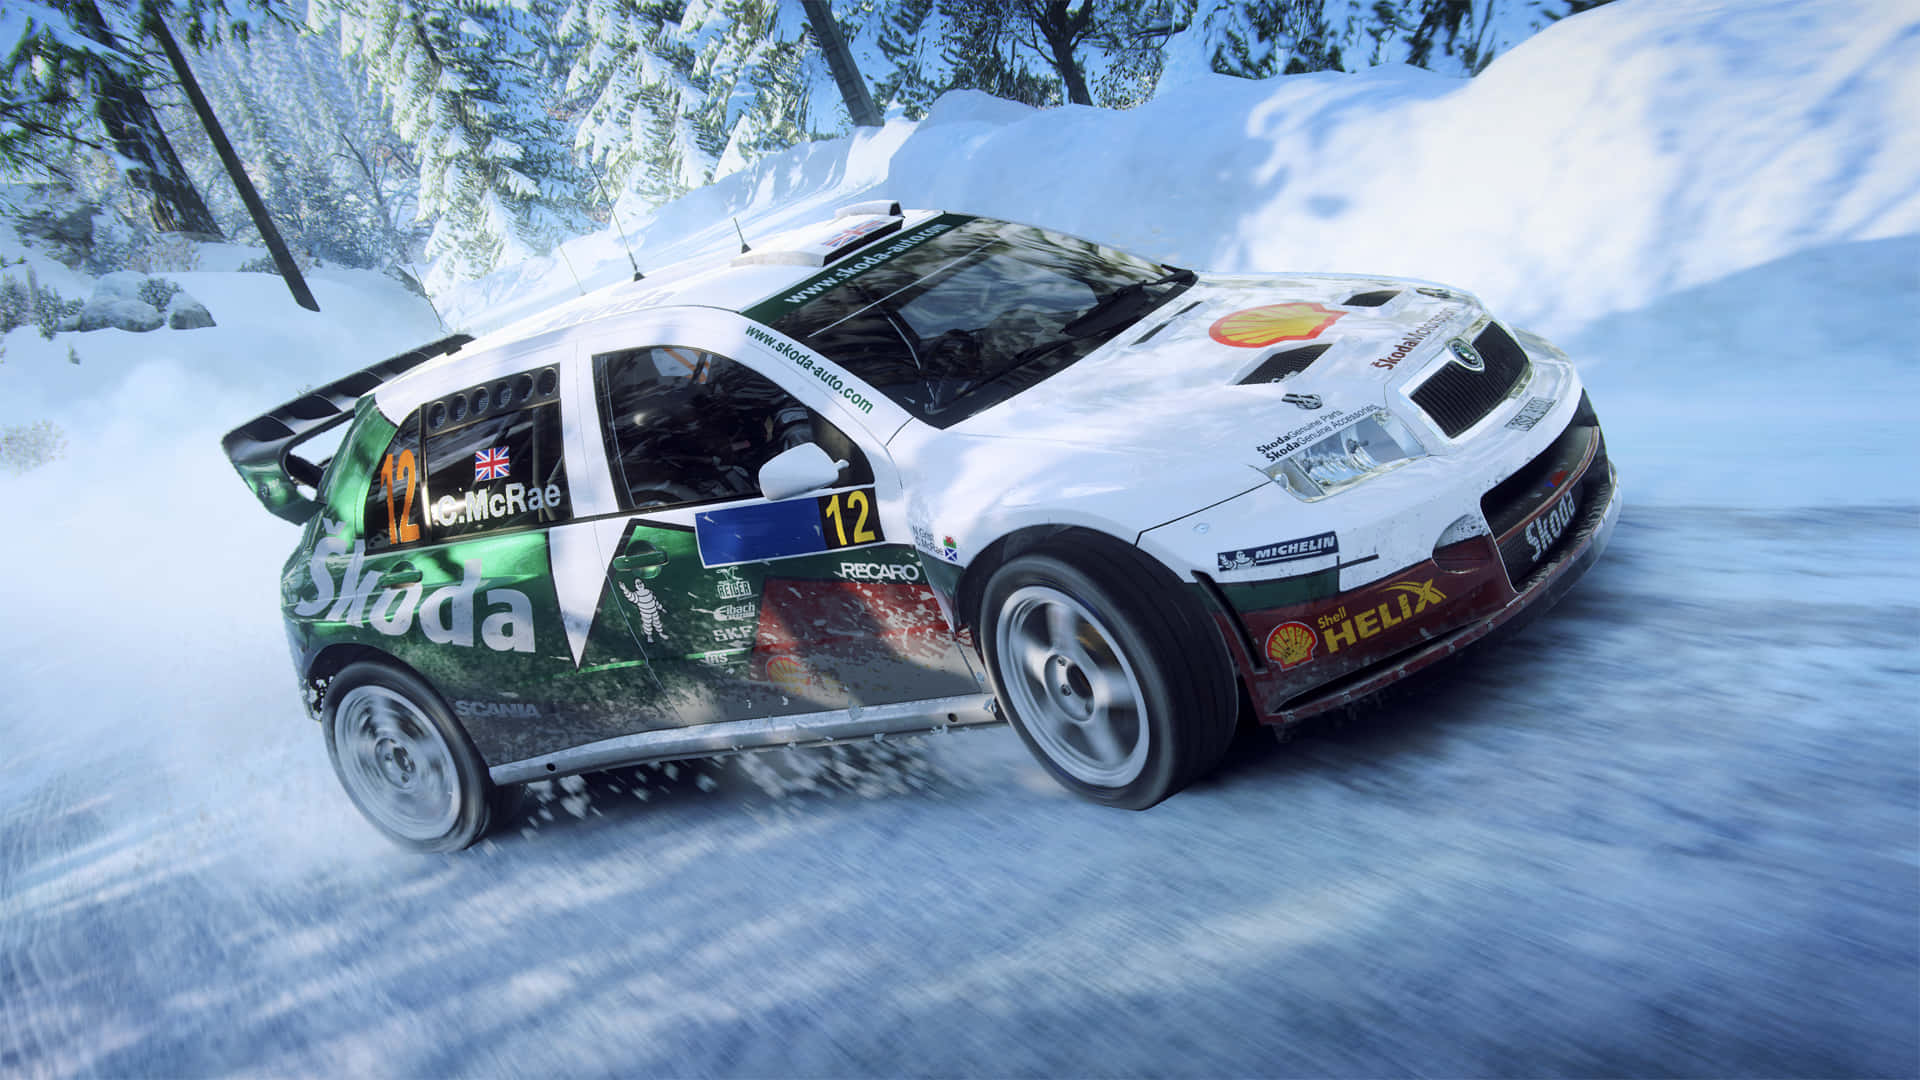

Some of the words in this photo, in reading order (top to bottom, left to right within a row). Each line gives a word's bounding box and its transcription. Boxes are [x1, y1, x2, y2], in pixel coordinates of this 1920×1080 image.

[784, 223, 950, 305] www.skoda-auto.com
[745, 325, 873, 414] www.skoda-auto.com
[381, 449, 420, 544] 12
[825, 491, 877, 547] 12
[1255, 534, 1335, 561] MICHELIN
[840, 561, 920, 581] RECARO
[712, 625, 753, 642] SKF
[1318, 606, 1347, 630] Shell
[1323, 579, 1447, 654] HELIX
[455, 700, 542, 718] SCANIA
